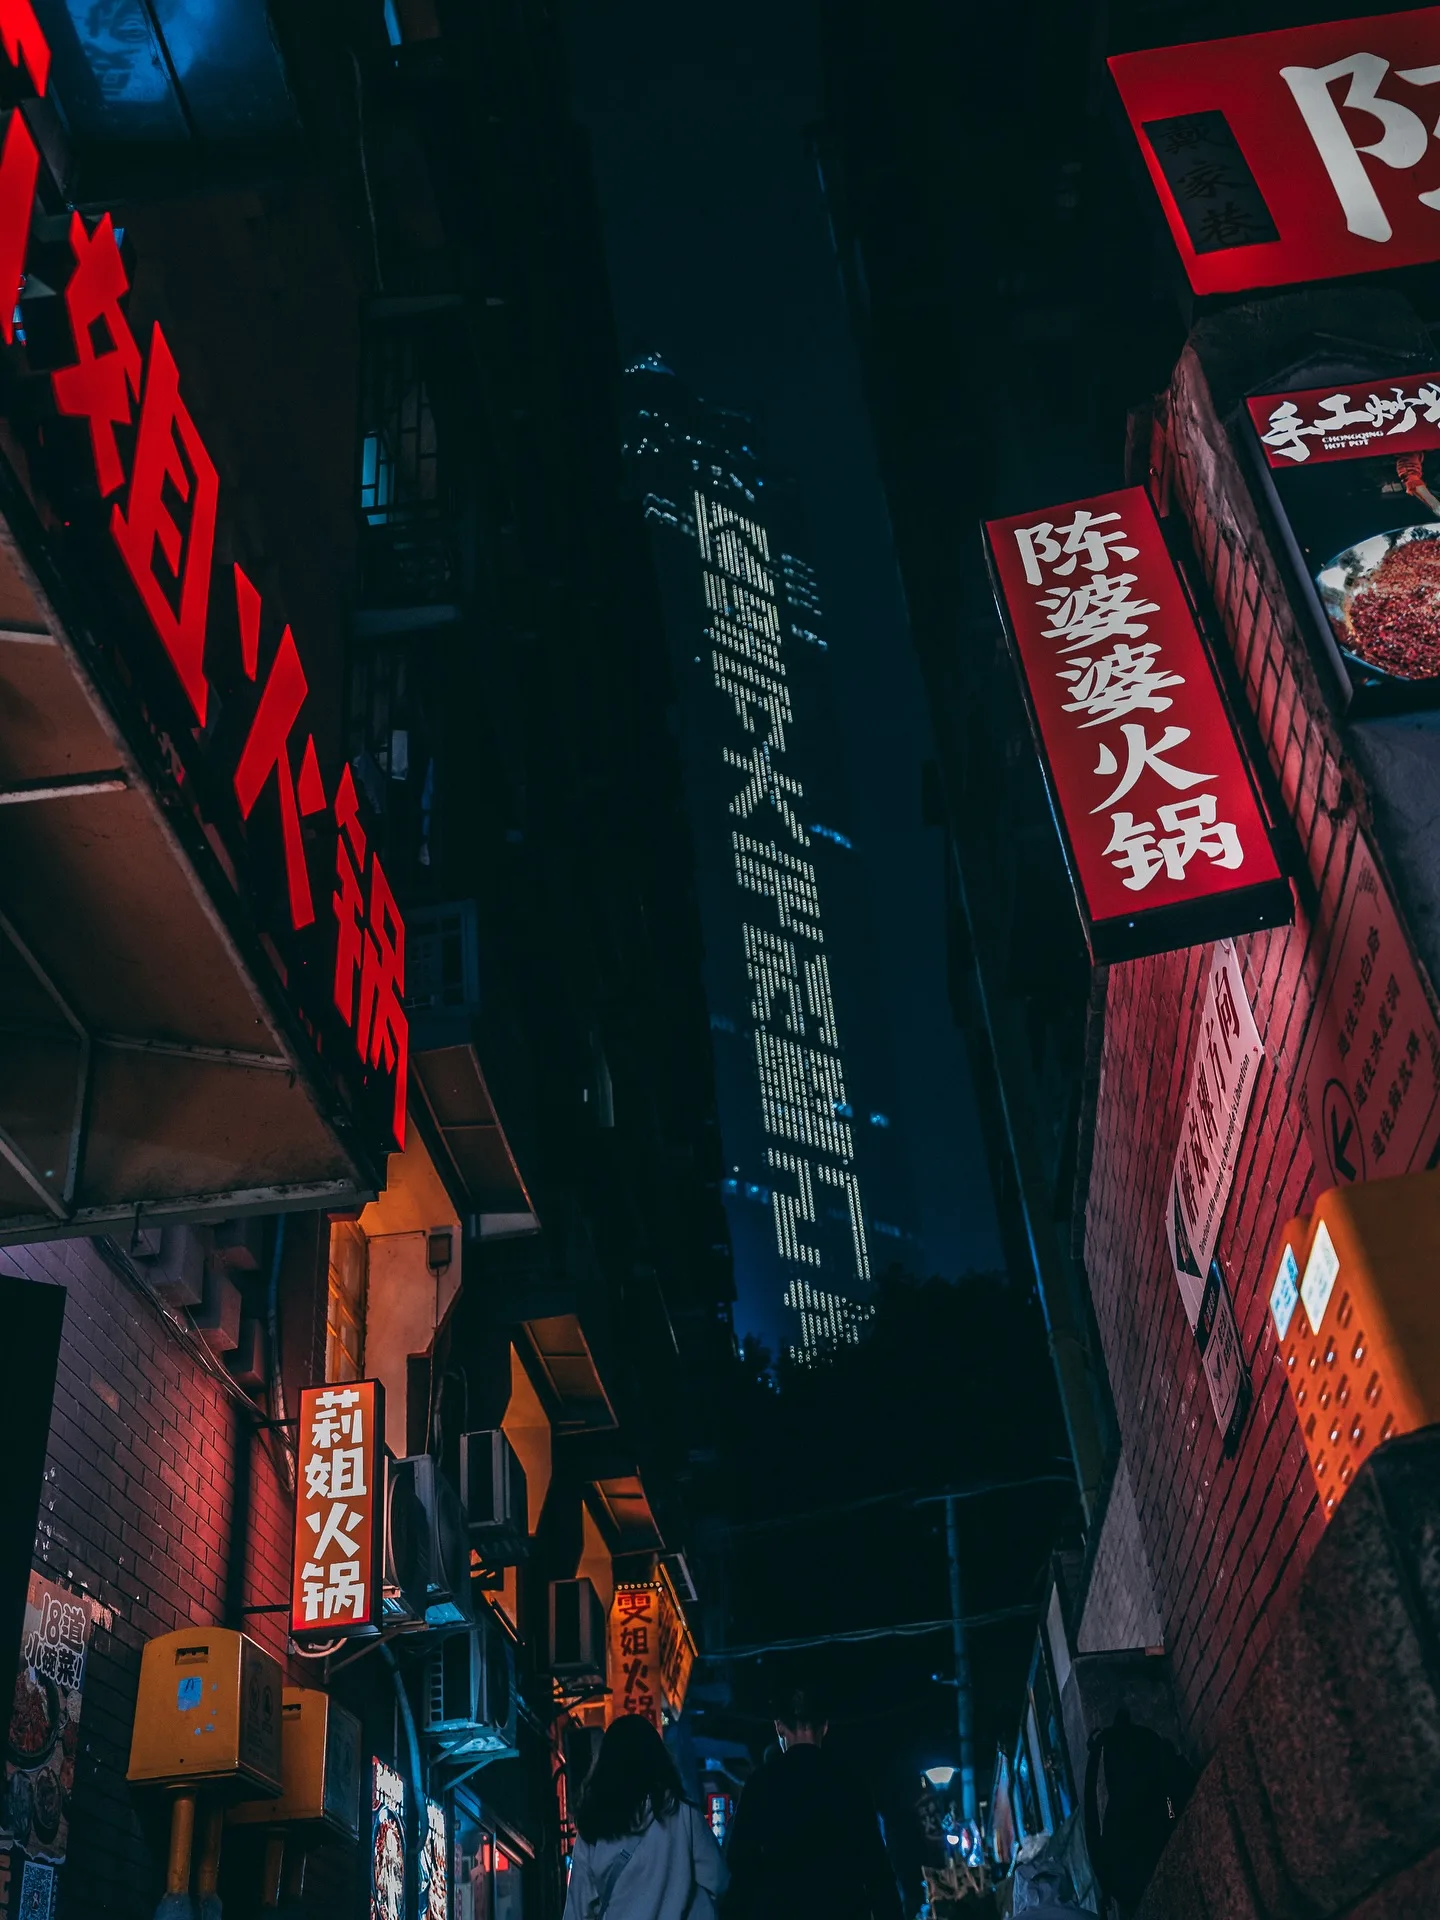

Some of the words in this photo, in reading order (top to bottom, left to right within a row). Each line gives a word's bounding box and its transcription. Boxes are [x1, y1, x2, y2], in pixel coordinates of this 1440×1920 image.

[1158, 118, 1269, 245] 戴家巷
[1322, 431, 1384, 443] CHONGQING
[1324, 442, 1346, 450] HOT
[1349, 439, 1370, 448] POT
[0, 0, 409, 1153] 姐火锅
[1014, 510, 1244, 891] 陈婆婆火锅
[1179, 965, 1242, 1230] 解放碑方向
[1199, 1220, 1211, 1256] Direction
[1233, 1054, 1249, 1106] Liberation
[301, 1390, 366, 1621] 莉姐火锅
[40, 1592, 86, 1655] 18道
